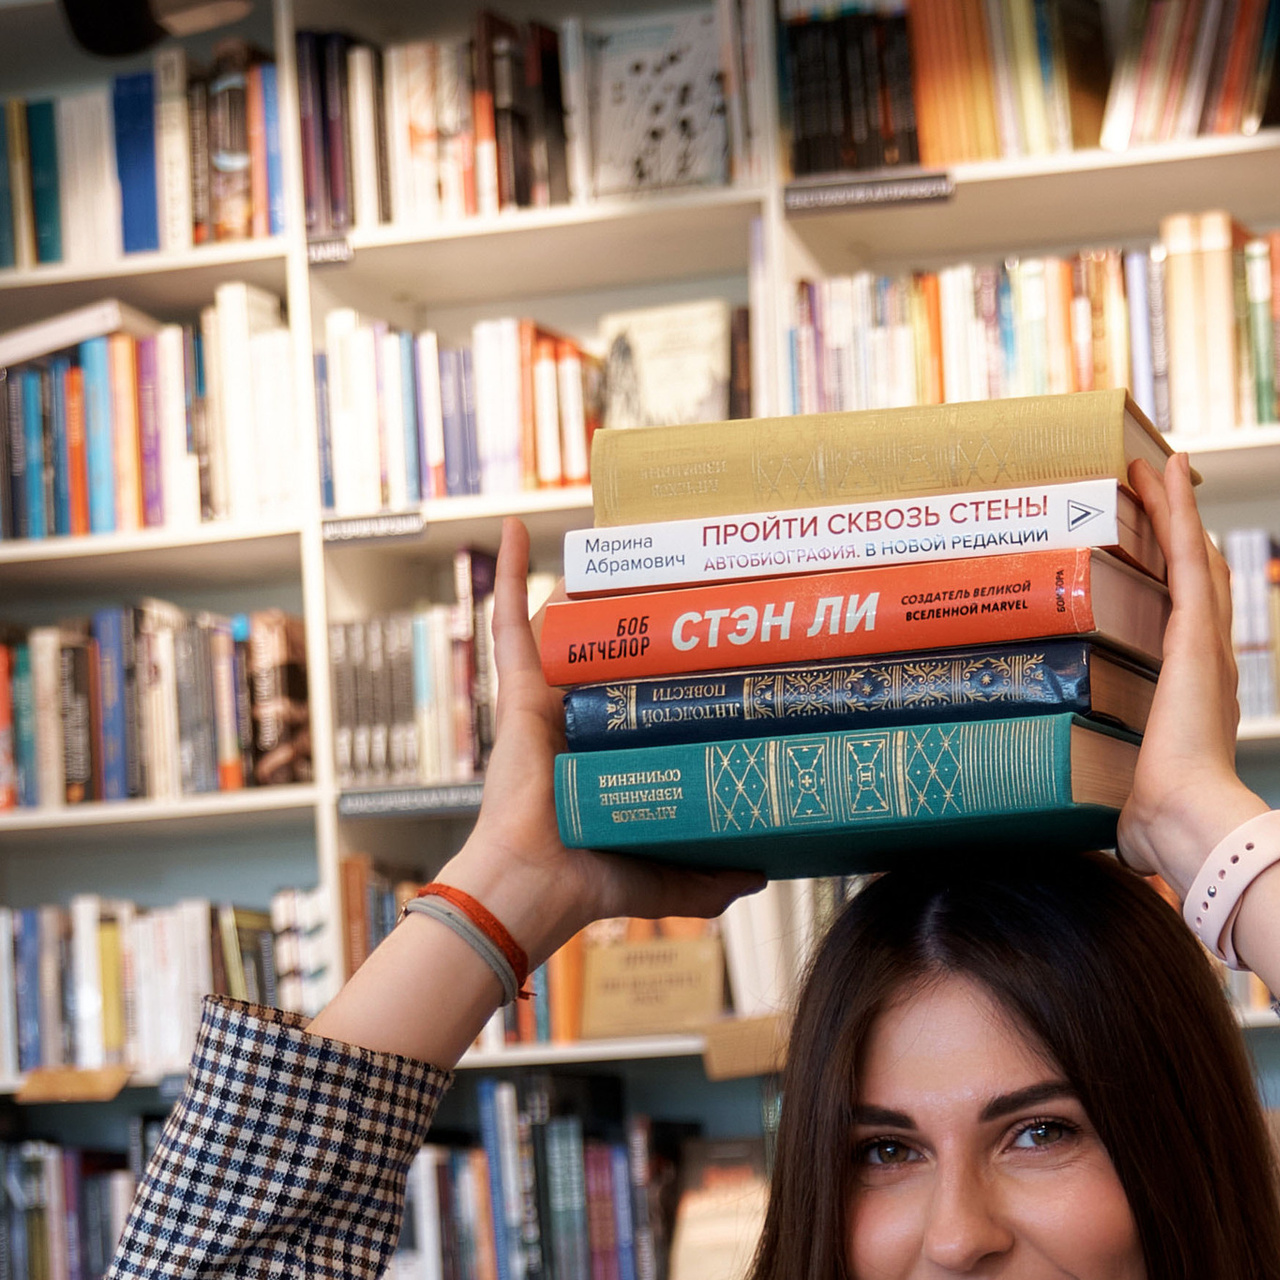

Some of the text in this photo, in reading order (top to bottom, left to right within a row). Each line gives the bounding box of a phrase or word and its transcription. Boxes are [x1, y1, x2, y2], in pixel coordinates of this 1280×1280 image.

[702, 495, 1048, 547] ПРОЙТИ СКВОЗЬ СТЕНЫ
[585, 536, 653, 554] Марина
[703, 528, 1048, 572] АВТОБИОГРАФИЯ. В НОВОЙ РЕДАКЦИИ
[585, 554, 685, 576] Абрамович
[901, 580, 1031, 606] СОЗДАТЕЛЬ ВЕЛИКОЙ
[905, 599, 1028, 621] ВСЕЛЕННОЙ MARVEL
[617, 616, 649, 637] БОБ
[671, 592, 880, 651] СТЭН ЛИ
[568, 636, 650, 664] БАТЧЕЛОР
[652, 684, 726, 701] ПОВЕСТИ
[598, 769, 682, 788] СОЧИНЕНИЯ
[600, 787, 683, 806] ИЗБРАННЫЕ
